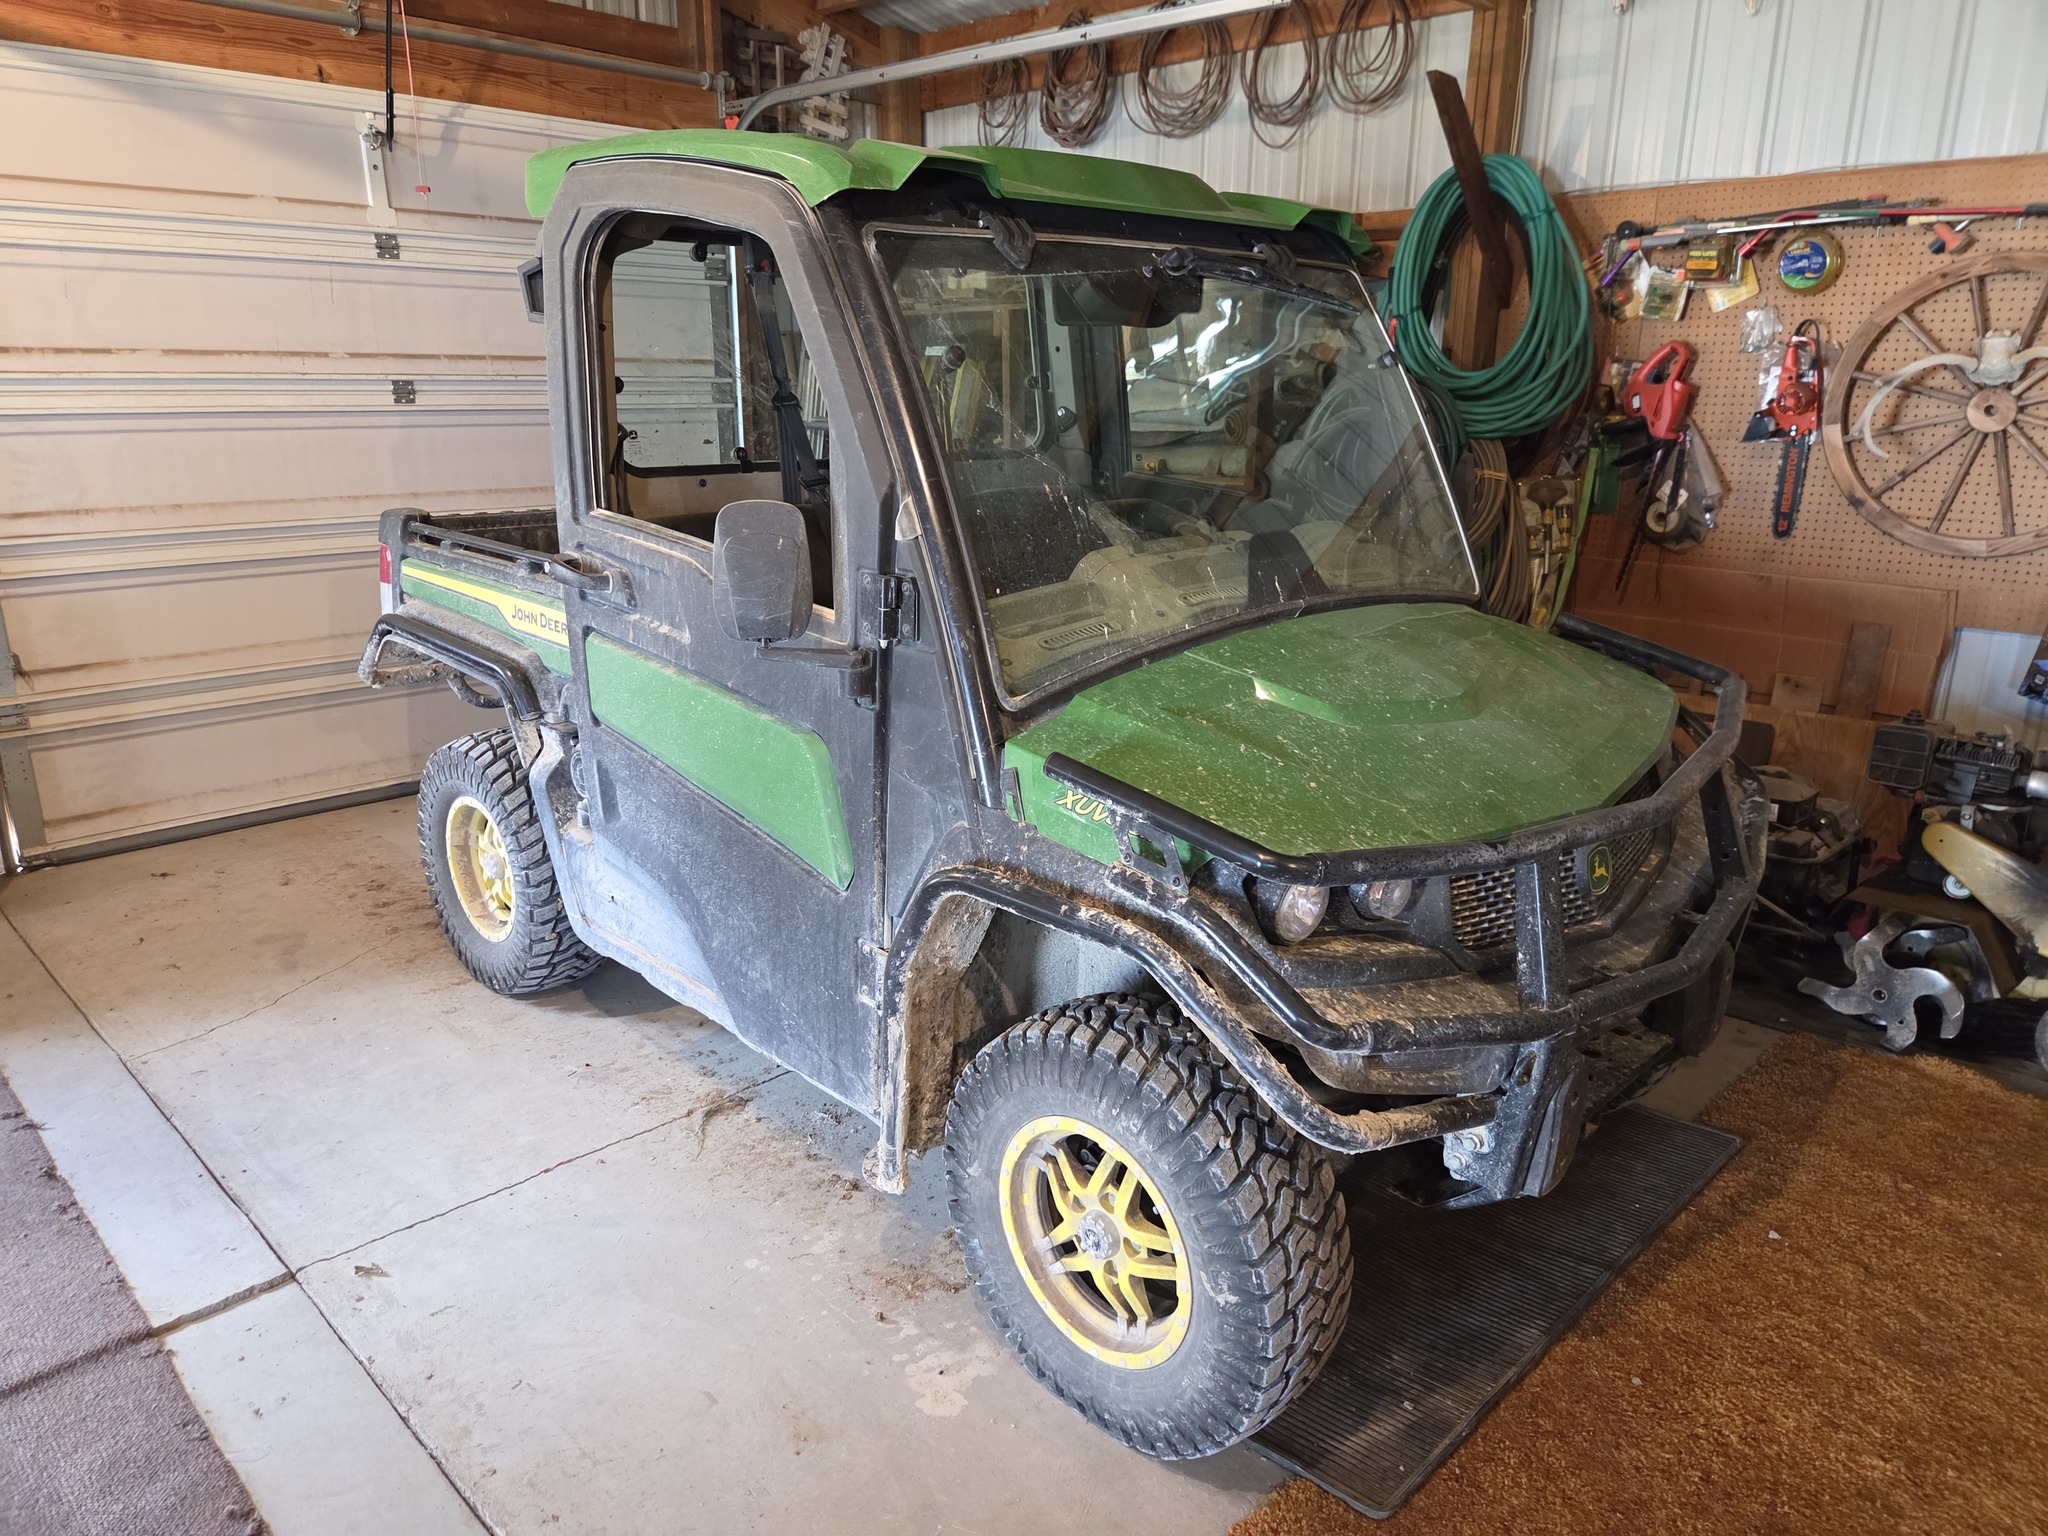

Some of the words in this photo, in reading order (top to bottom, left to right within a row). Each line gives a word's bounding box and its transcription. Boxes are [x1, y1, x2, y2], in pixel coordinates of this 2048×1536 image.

[1780, 447, 1799, 513] REMINGTON
[511, 604, 538, 626] JOHN
[540, 612, 568, 636] DEER
